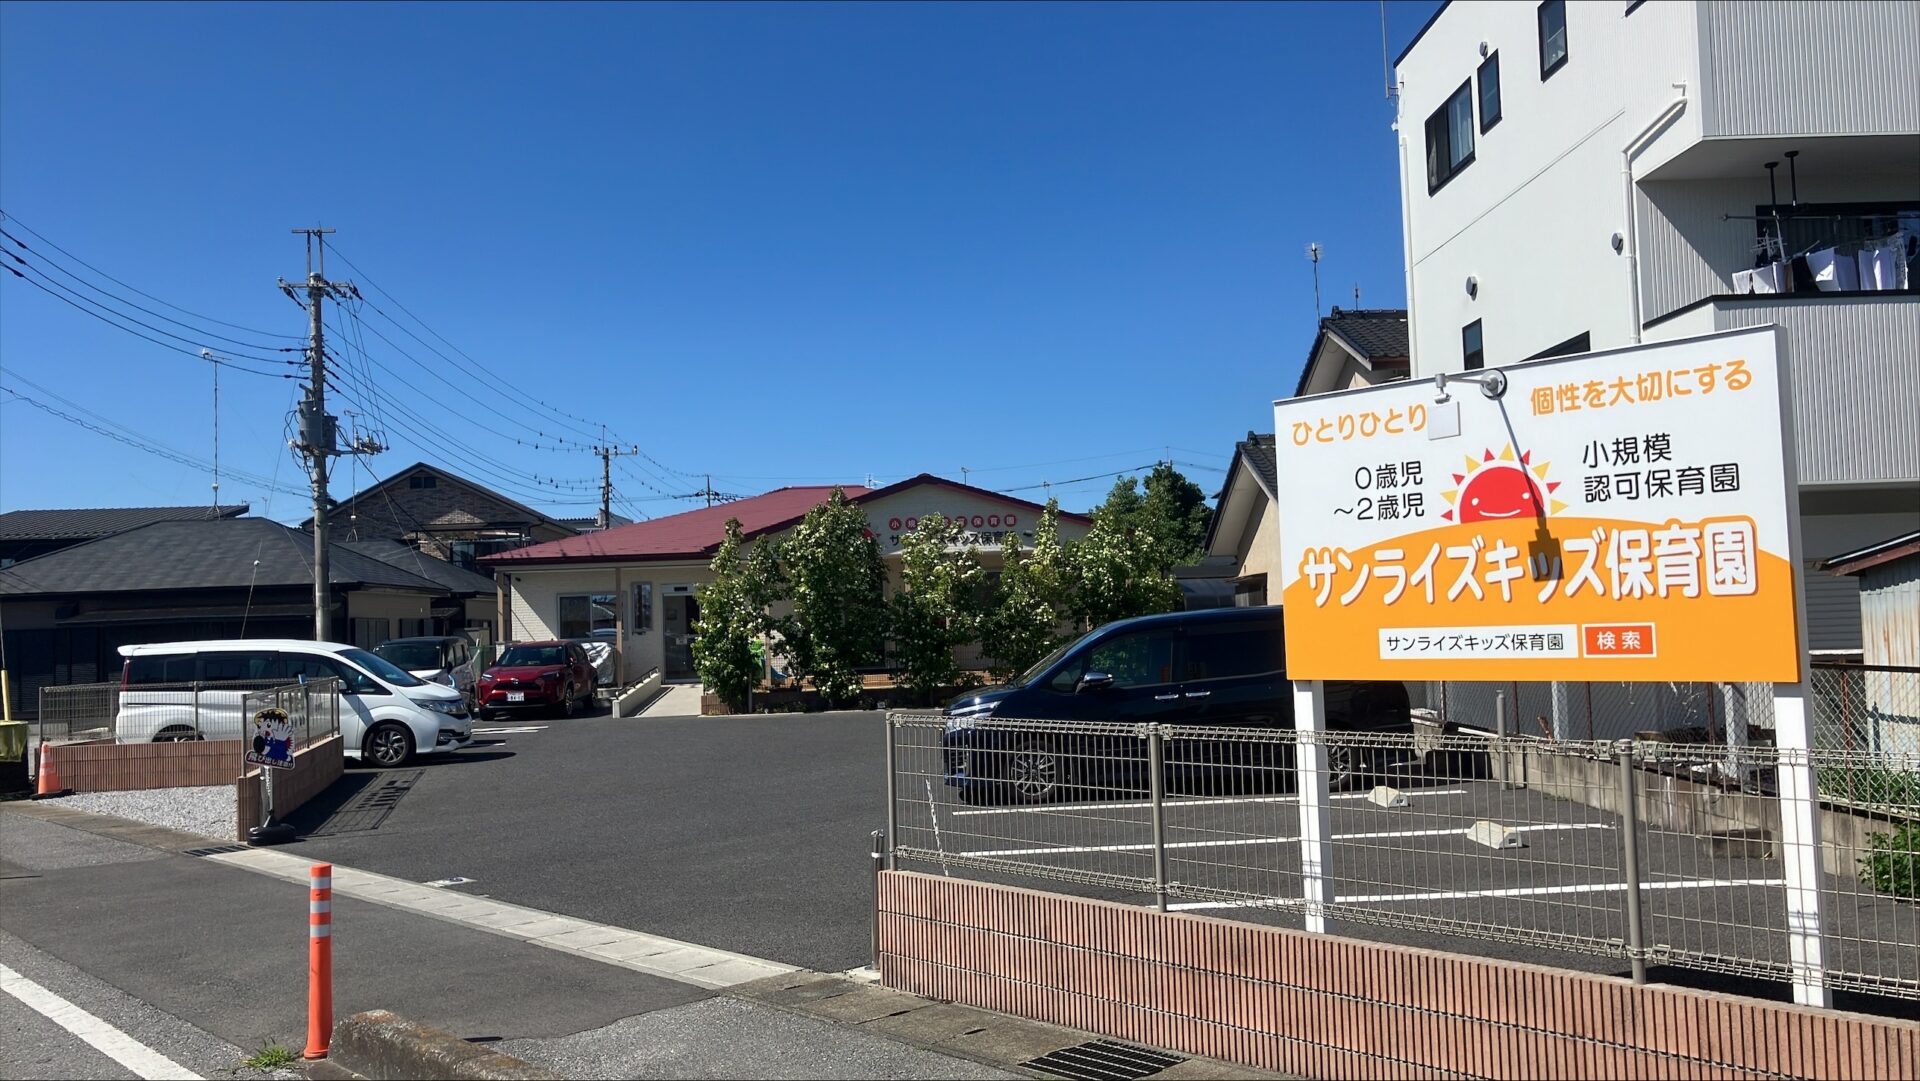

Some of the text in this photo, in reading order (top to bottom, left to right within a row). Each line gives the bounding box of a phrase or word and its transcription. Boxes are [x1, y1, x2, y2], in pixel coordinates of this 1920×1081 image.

[1531, 360, 1752, 416] 個性を大切にする
[1292, 404, 1426, 446] ひとりひとり
[1582, 432, 1672, 468] 小規模
[1355, 460, 1423, 490] 0歳児
[1584, 463, 1740, 503] 認可保育園
[1303, 521, 1758, 607] サンライズキッズ保育園
[1386, 633, 1563, 652] サンライズキッズ保育園
